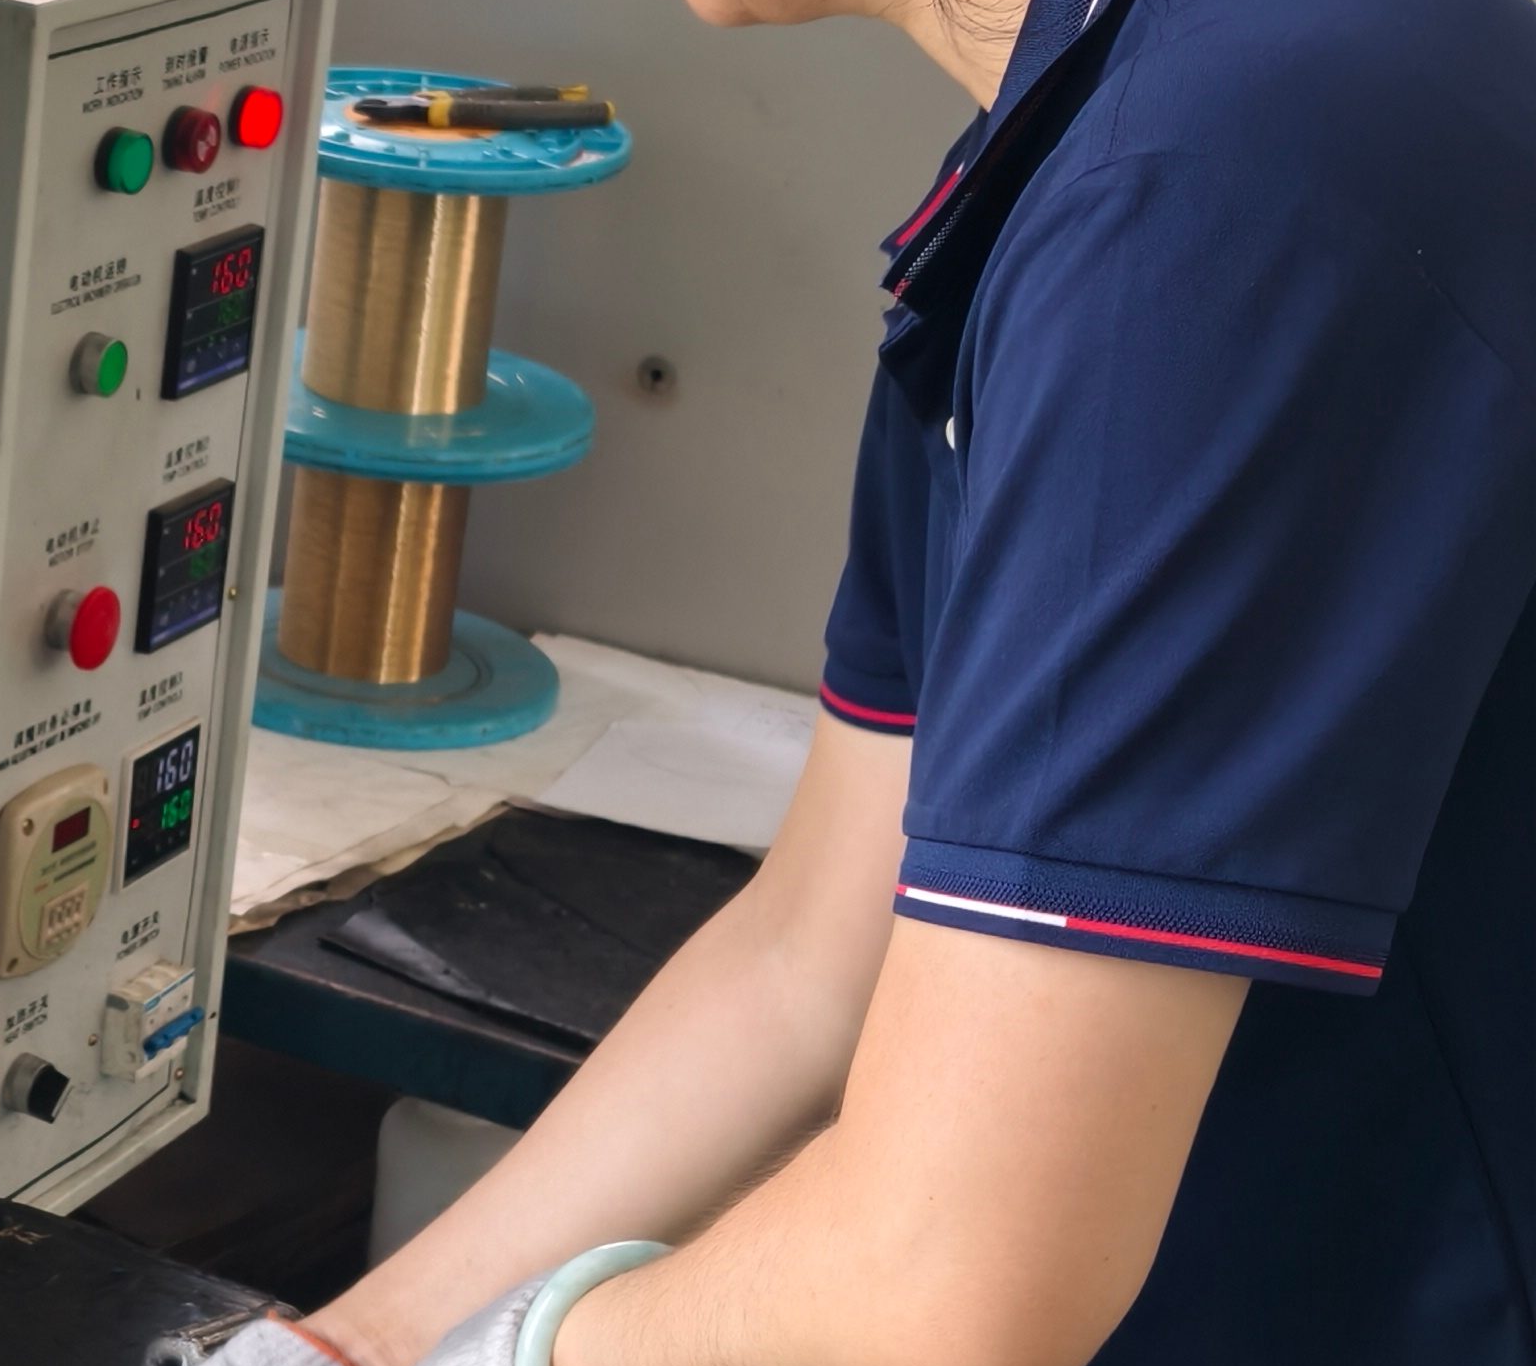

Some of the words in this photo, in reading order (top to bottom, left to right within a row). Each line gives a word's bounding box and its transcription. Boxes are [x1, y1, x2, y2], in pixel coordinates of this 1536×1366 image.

[210, 247, 251, 295] 160
[182, 501, 222, 551] 160
[156, 739, 194, 793] 160
